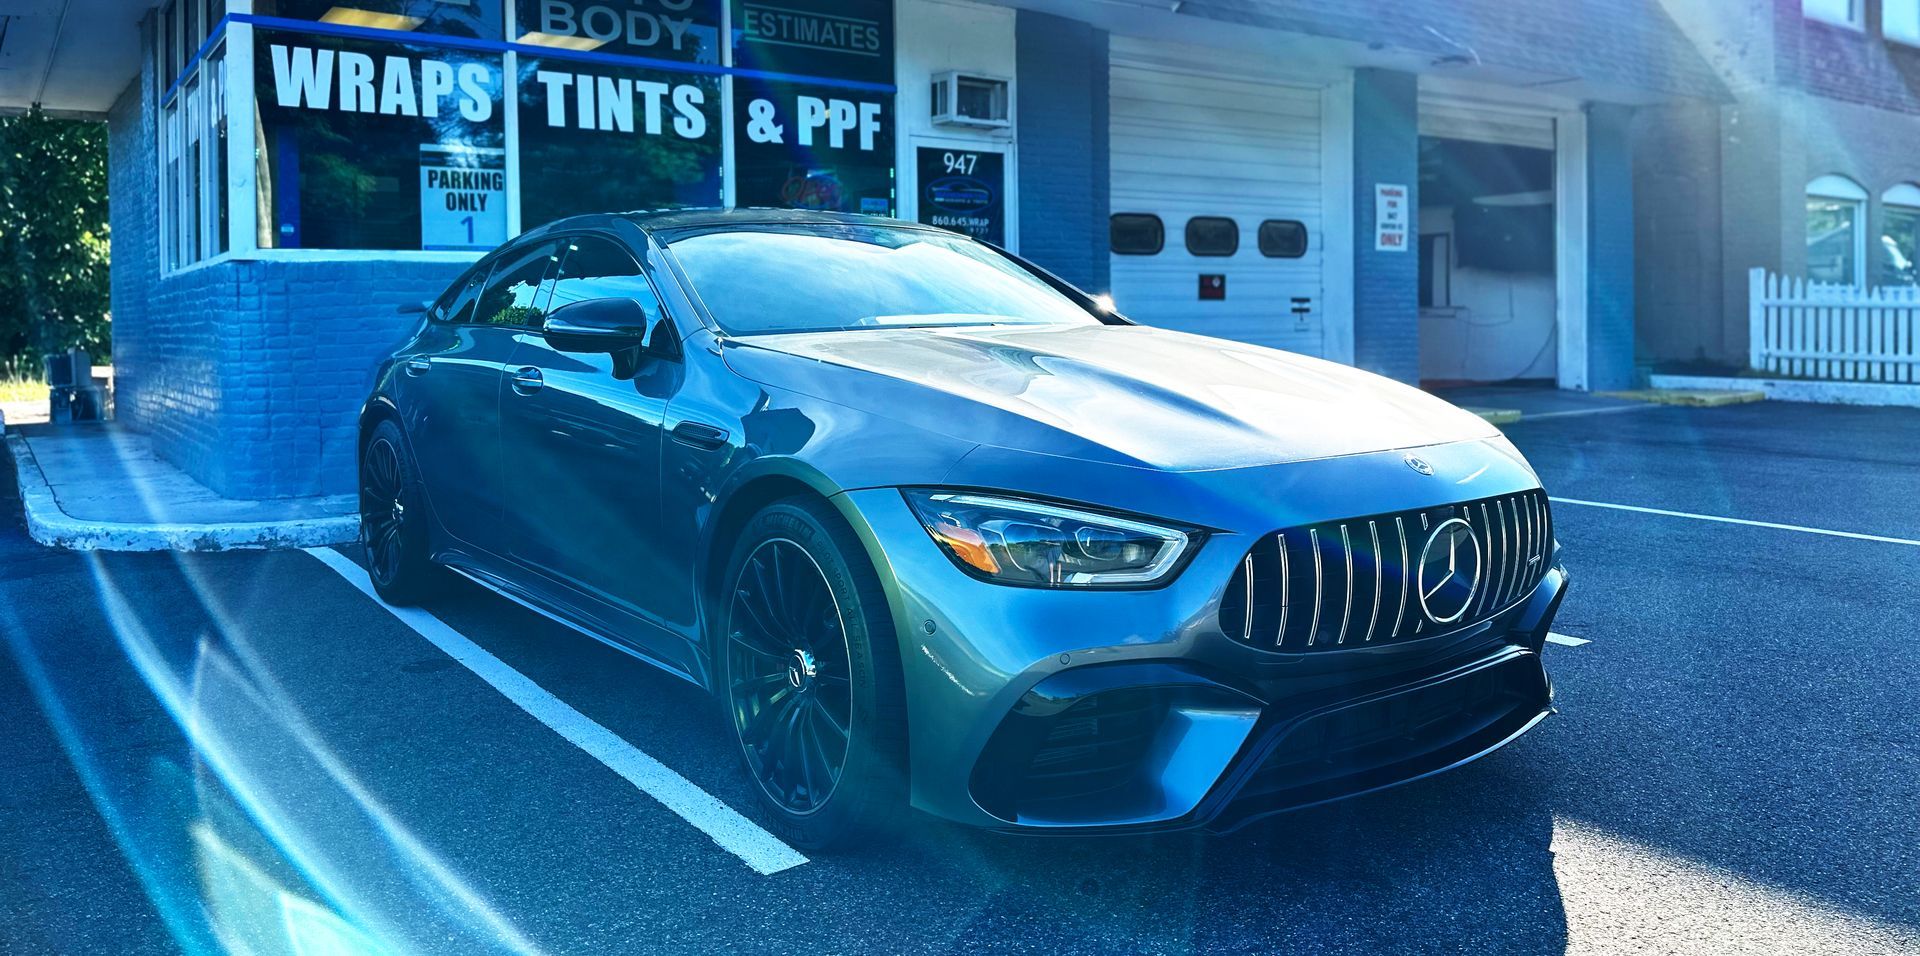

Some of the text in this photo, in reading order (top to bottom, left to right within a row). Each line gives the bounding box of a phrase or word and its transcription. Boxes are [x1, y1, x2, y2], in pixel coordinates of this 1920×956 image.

[540, 0, 693, 51] BODY
[744, 9, 880, 51] ESTIMATES
[270, 44, 492, 122] WRAPS
[536, 70, 707, 140] TINTS
[746, 98, 784, 144] &
[797, 95, 881, 151] PPF
[943, 152, 977, 175] 947
[427, 169, 504, 192] PARKING
[445, 191, 489, 213] ONLY
[460, 215, 475, 244] 1
[932, 215, 990, 228] 860.645.WRAP
[833, 567, 851, 601] SPORT
